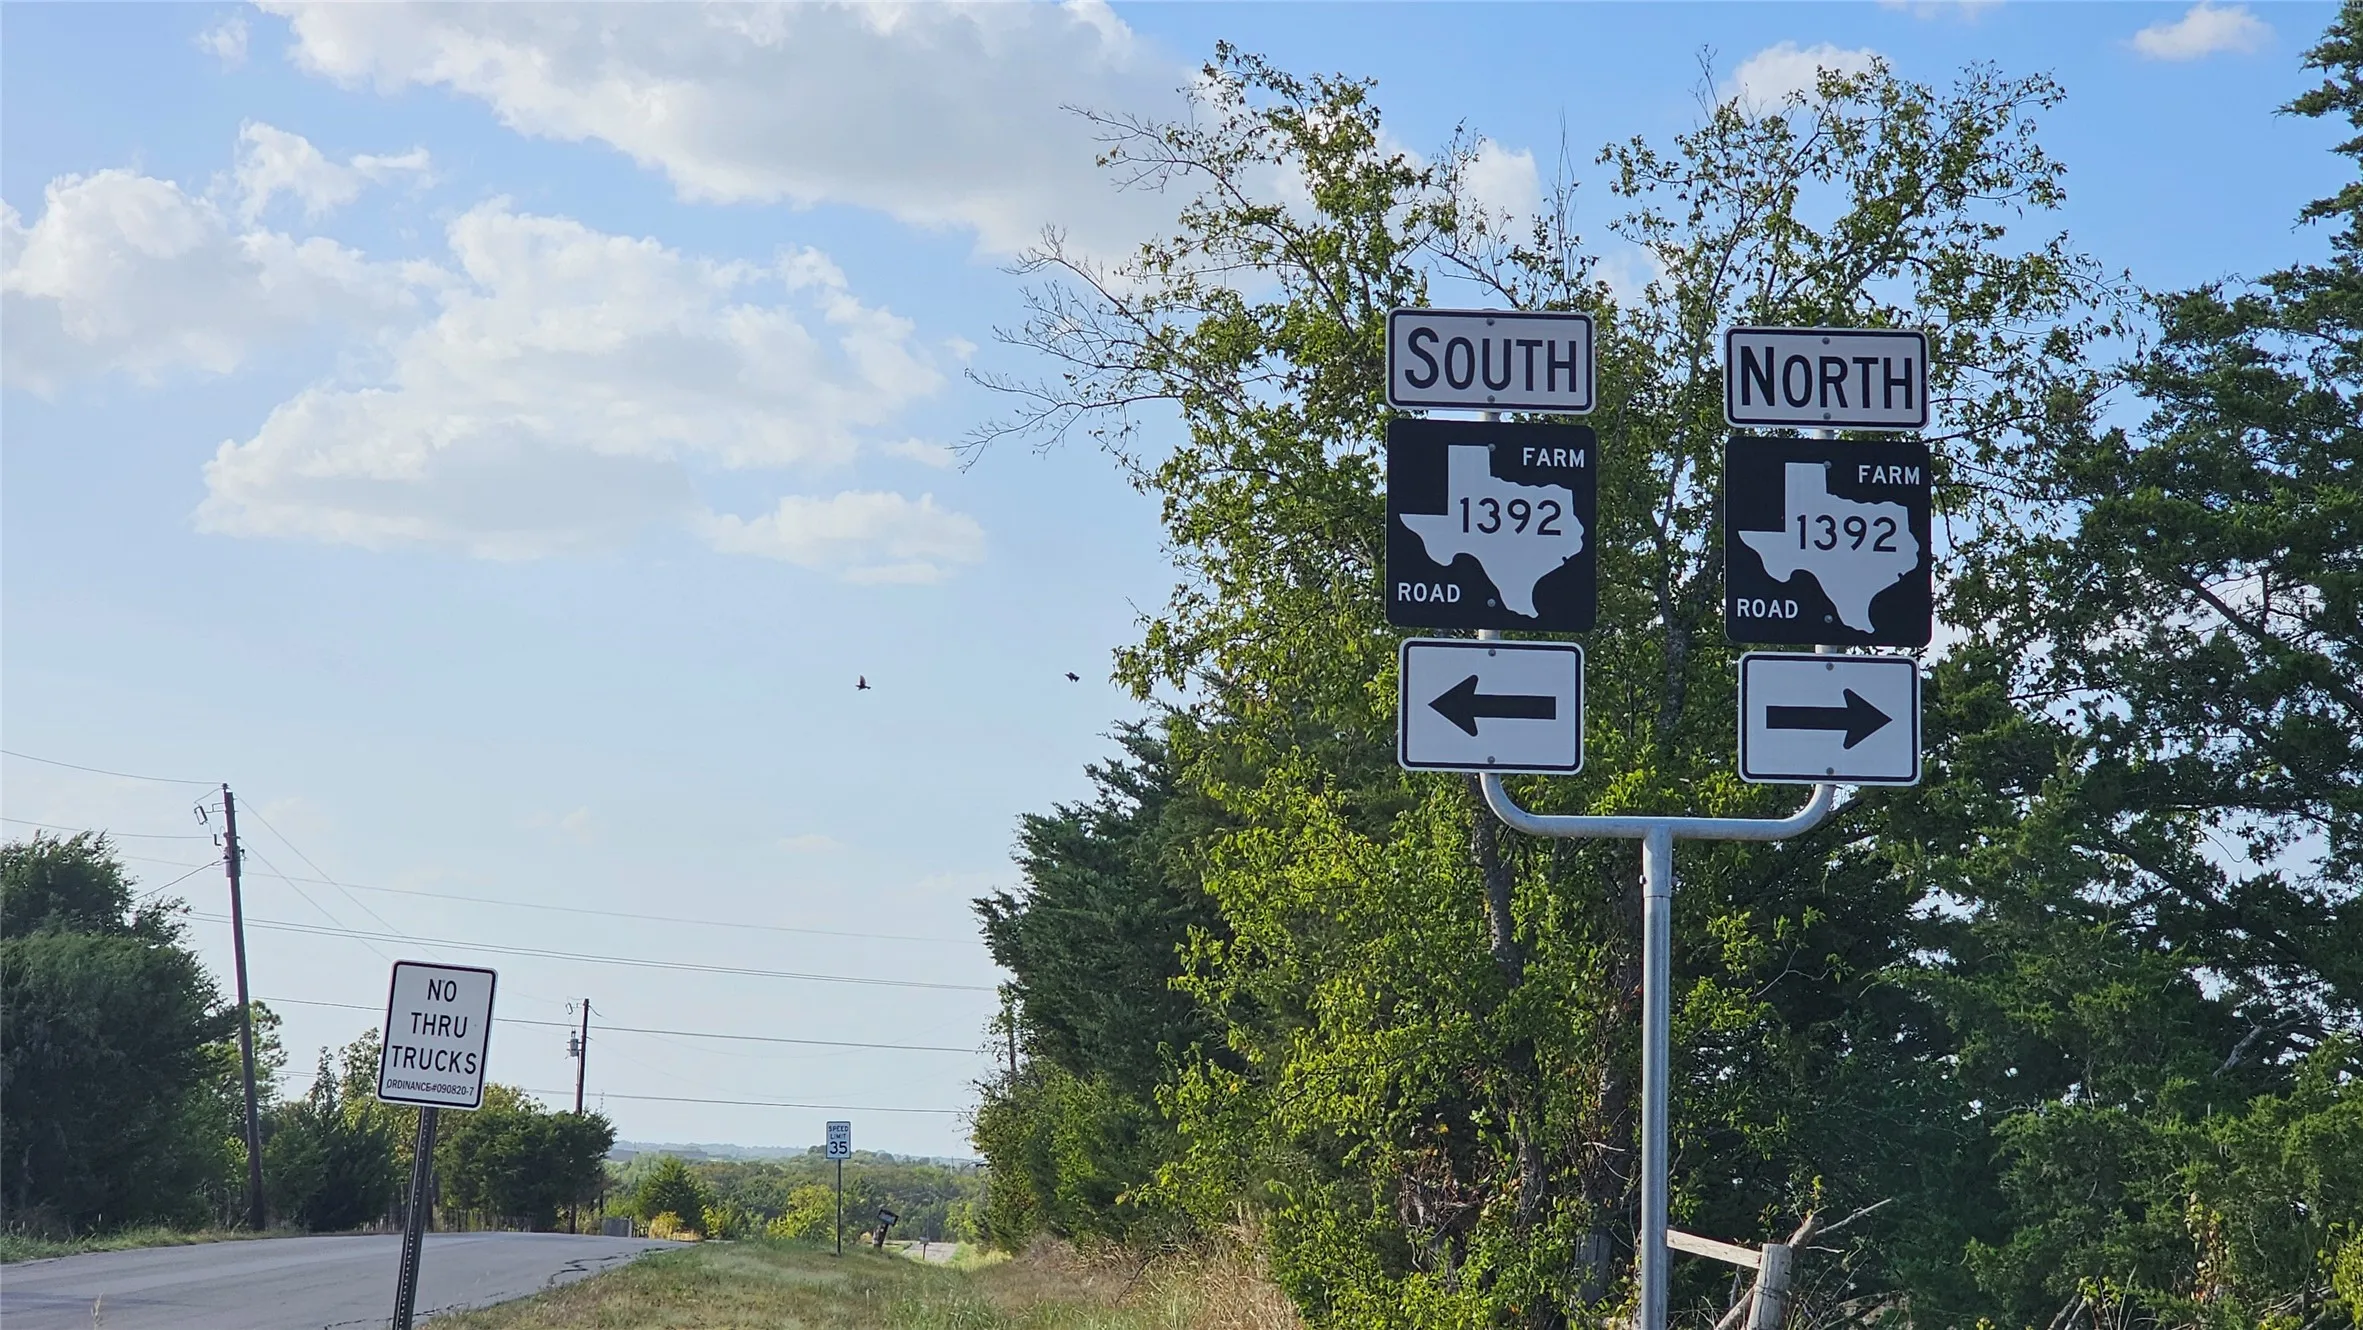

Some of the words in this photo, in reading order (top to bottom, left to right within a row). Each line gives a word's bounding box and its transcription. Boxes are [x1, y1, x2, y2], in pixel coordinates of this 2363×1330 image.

[1404, 326, 1577, 393] SOUTH
[1740, 345, 1913, 410] NORTH
[1522, 447, 1585, 468] FARM
[1858, 465, 1920, 485] FARM
[1460, 497, 1562, 536] 1392
[1796, 514, 1897, 552] 1392
[1398, 582, 1461, 603] ROAD
[1736, 598, 1799, 619] ROAD
[427, 978, 457, 1002] NO
[411, 1011, 468, 1038] THRU
[391, 1045, 477, 1075] TRUCKS
[829, 1141, 848, 1155] 35
